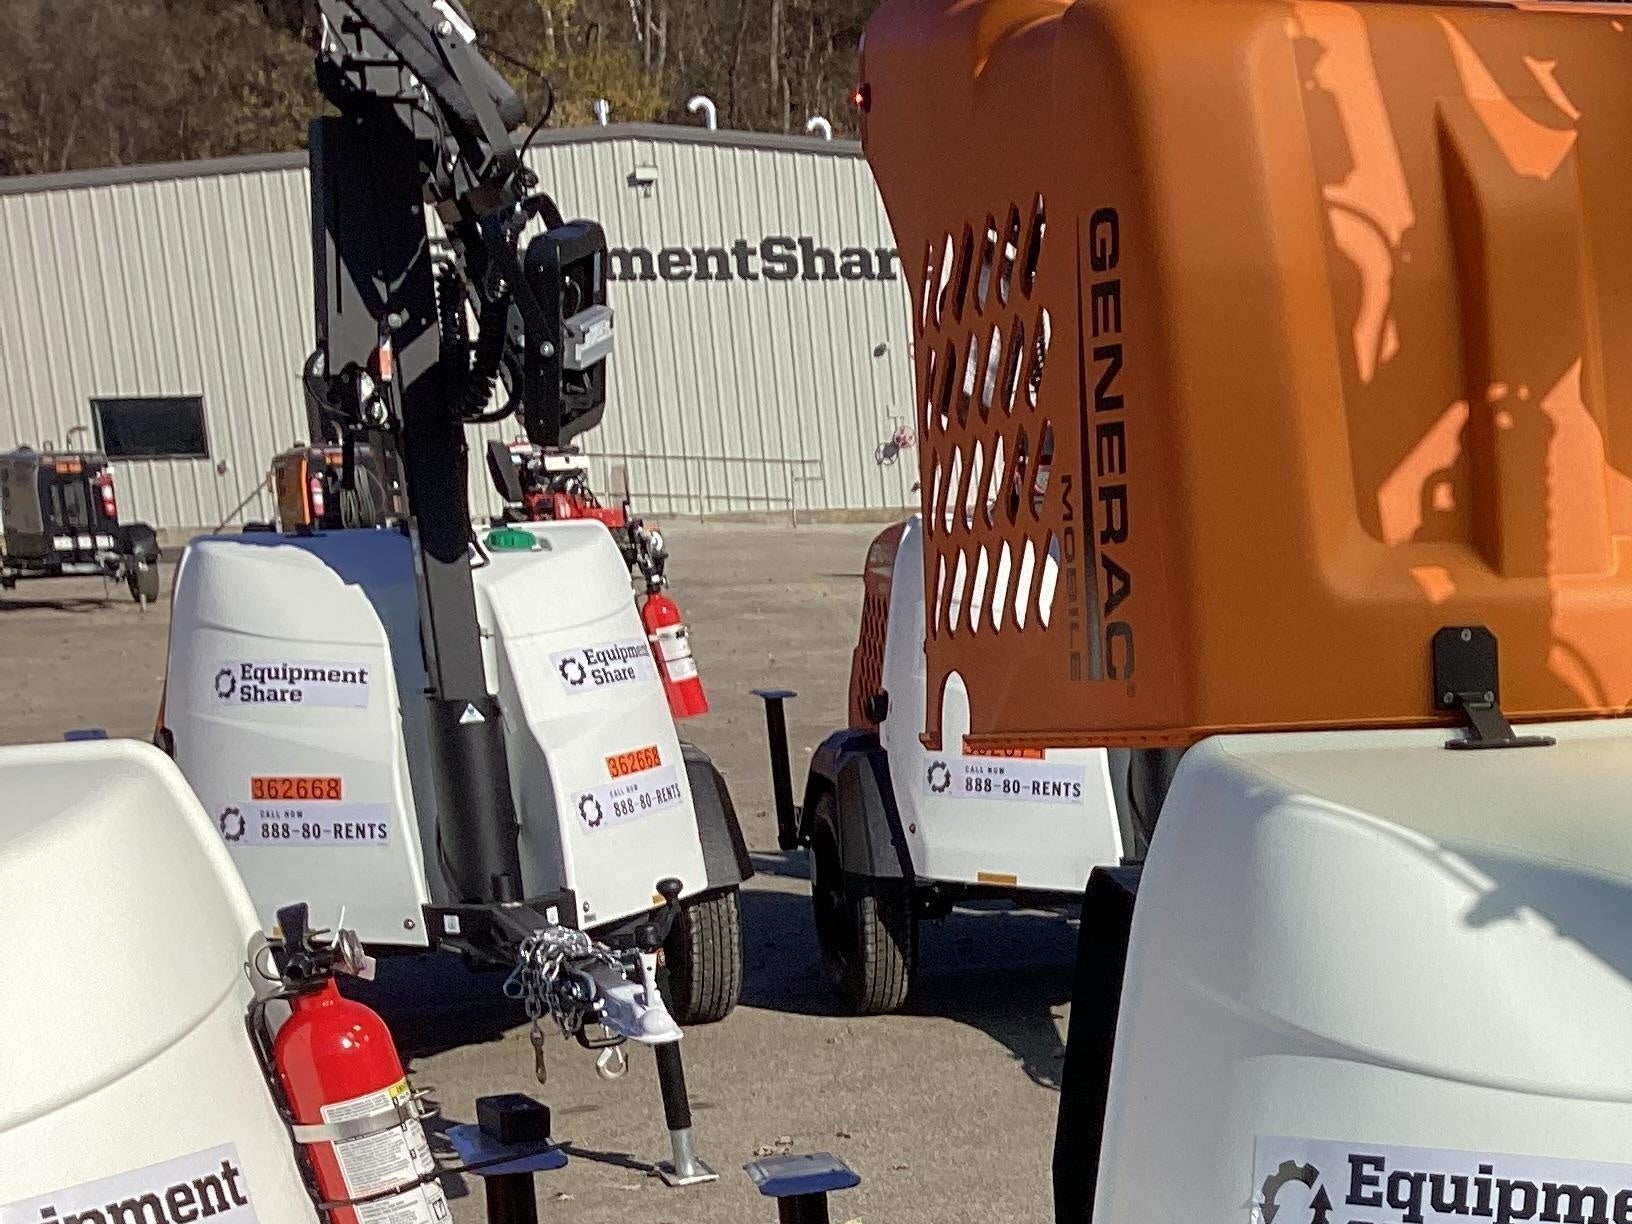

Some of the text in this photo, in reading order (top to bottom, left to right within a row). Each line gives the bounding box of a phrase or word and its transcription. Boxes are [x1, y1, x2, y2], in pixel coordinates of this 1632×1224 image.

[606, 236, 899, 281] mentShar
[1089, 207, 1135, 682] GENERAC
[1060, 474, 1082, 682] MOBILE
[240, 662, 369, 685] Equipment
[591, 667, 636, 686] Share
[240, 685, 303, 703] Share
[965, 765, 1005, 775] CALL NOW
[254, 777, 340, 800] 362668
[965, 776, 1082, 798] 888-80-RENTS
[613, 782, 681, 817] 888-80-RENTS
[260, 809, 303, 819] CALL NOW
[261, 822, 388, 840] 888-80-RENTS
